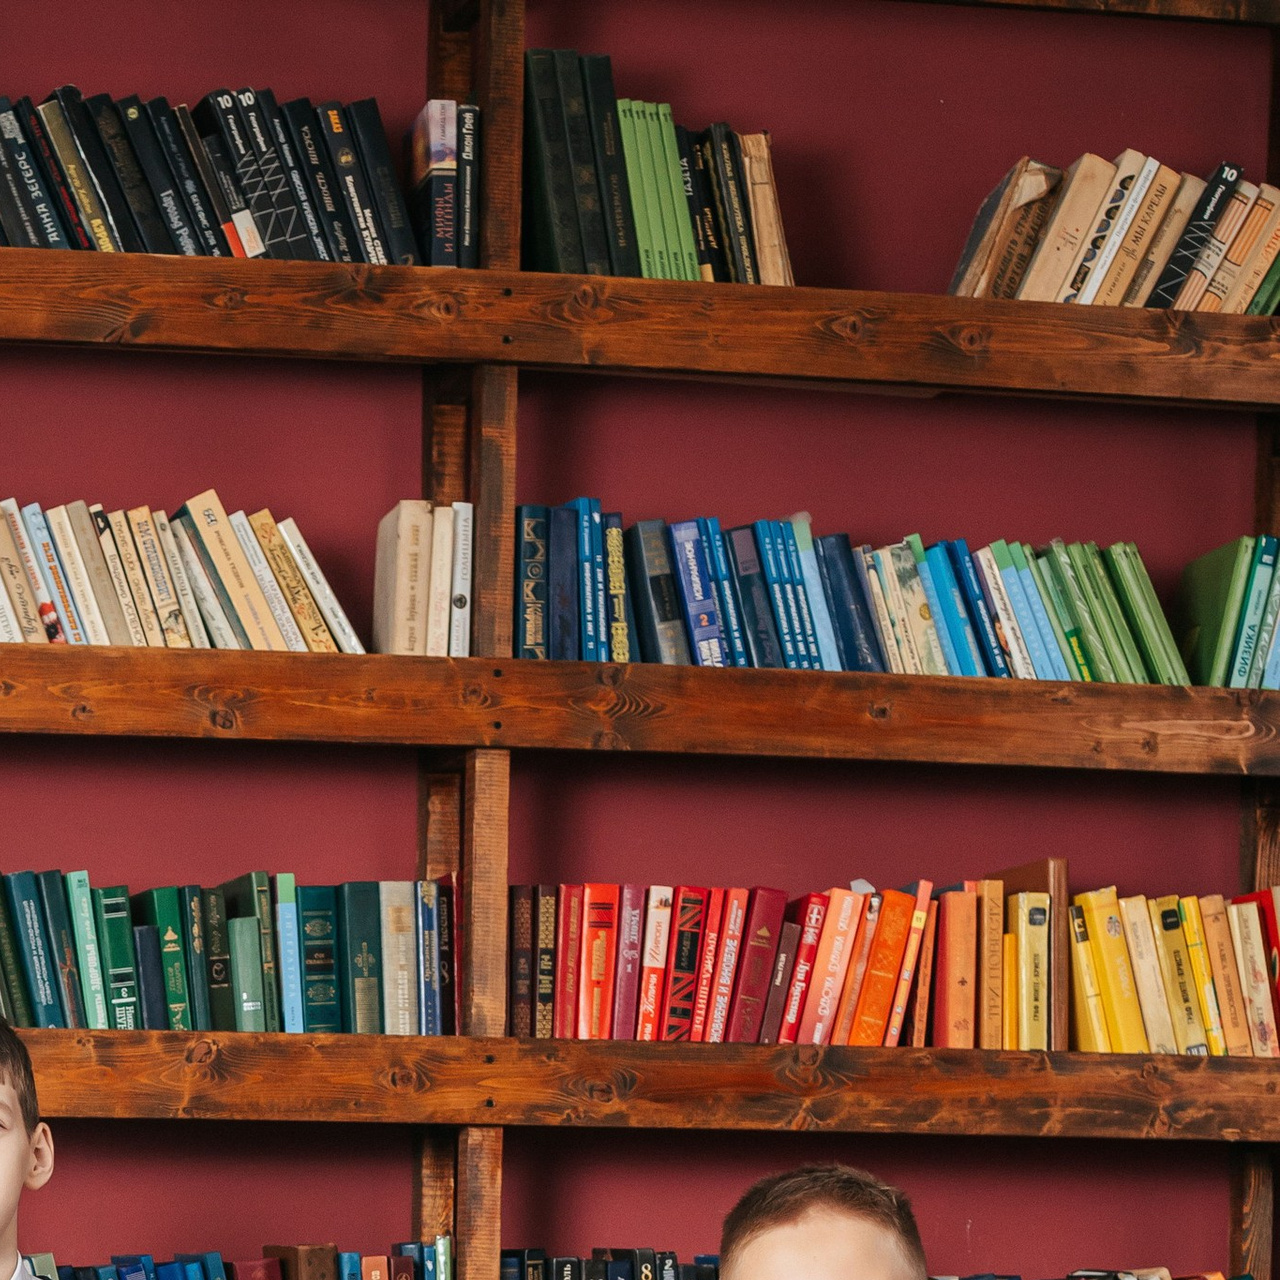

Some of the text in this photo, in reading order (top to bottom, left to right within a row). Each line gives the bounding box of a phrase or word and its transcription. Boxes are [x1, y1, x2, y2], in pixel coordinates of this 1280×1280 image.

[217, 94, 232, 109] 10
[238, 91, 254, 106] 10
[225, 113, 247, 154] География
[247, 111, 268, 152] География
[463, 112, 474, 159] Джон Грей
[14, 149, 61, 243] АННА ЗЕГЕРС
[1222, 166, 1238, 182] 10
[434, 197, 445, 237] МИФЫ
[442, 183, 455, 251] И ЛЕГЕНДЫ
[1129, 182, 1169, 246] МЫ КАРЕЛЫ
[1201, 183, 1226, 220] География
[684, 540, 704, 600] ИЗБРАННОЕ
[1236, 623, 1258, 677] ФИЗИКА
[720, 938, 737, 984] ВИНОДЕЛИЕ
[988, 896, 1001, 1019] ТРИ ПОВЕСТИ
[693, 932, 717, 1031] КРОЙКА ШИТЬЕ
[786, 959, 810, 1023] Луи Буссенар
[640, 1255, 652, 1275] 8
